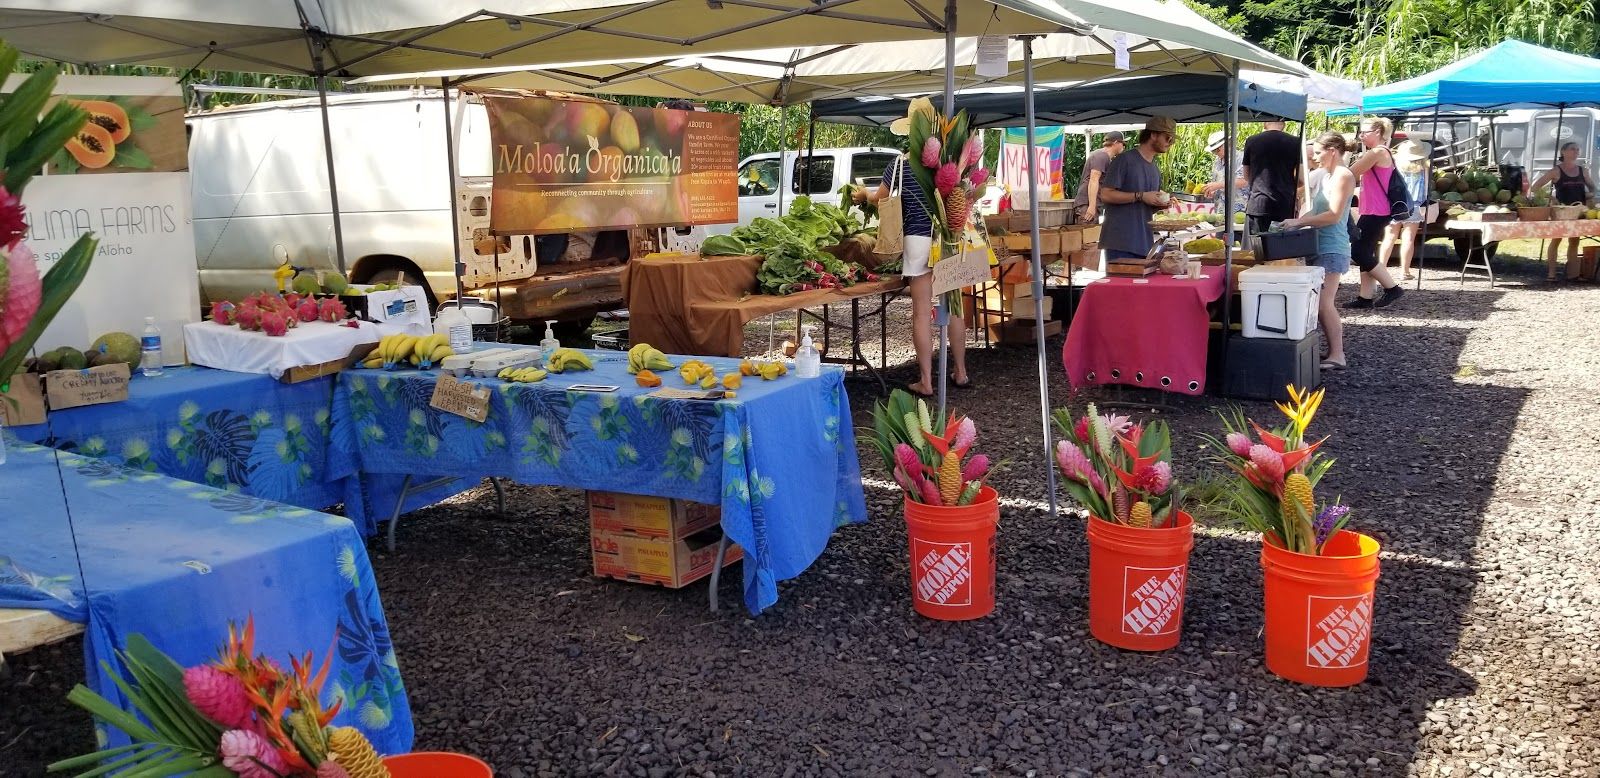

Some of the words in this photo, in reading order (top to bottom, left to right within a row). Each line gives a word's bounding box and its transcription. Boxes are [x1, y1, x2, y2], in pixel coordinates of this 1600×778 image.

[497, 142, 581, 174] Moloa'a
[586, 147, 682, 182] Organica'a
[542, 189, 577, 197] Reconnecting
[607, 188, 626, 197] through
[101, 205, 176, 236] FARMS
[99, 243, 133, 257] Aloha
[438, 387, 476, 404] HARVESTED
[443, 379, 472, 395] FRESH
[593, 536, 618, 552] Dole
[690, 549, 711, 570] Dole
[918, 544, 971, 601] HOME
[920, 549, 941, 571] THE
[935, 566, 970, 604] DEPOT
[1131, 576, 1160, 602] THE
[1124, 567, 1183, 634] HOME
[1149, 589, 1181, 634] DEPOT
[1309, 595, 1370, 667] HOME
[1316, 605, 1349, 634] THE
[1337, 621, 1370, 667] DEPOT
